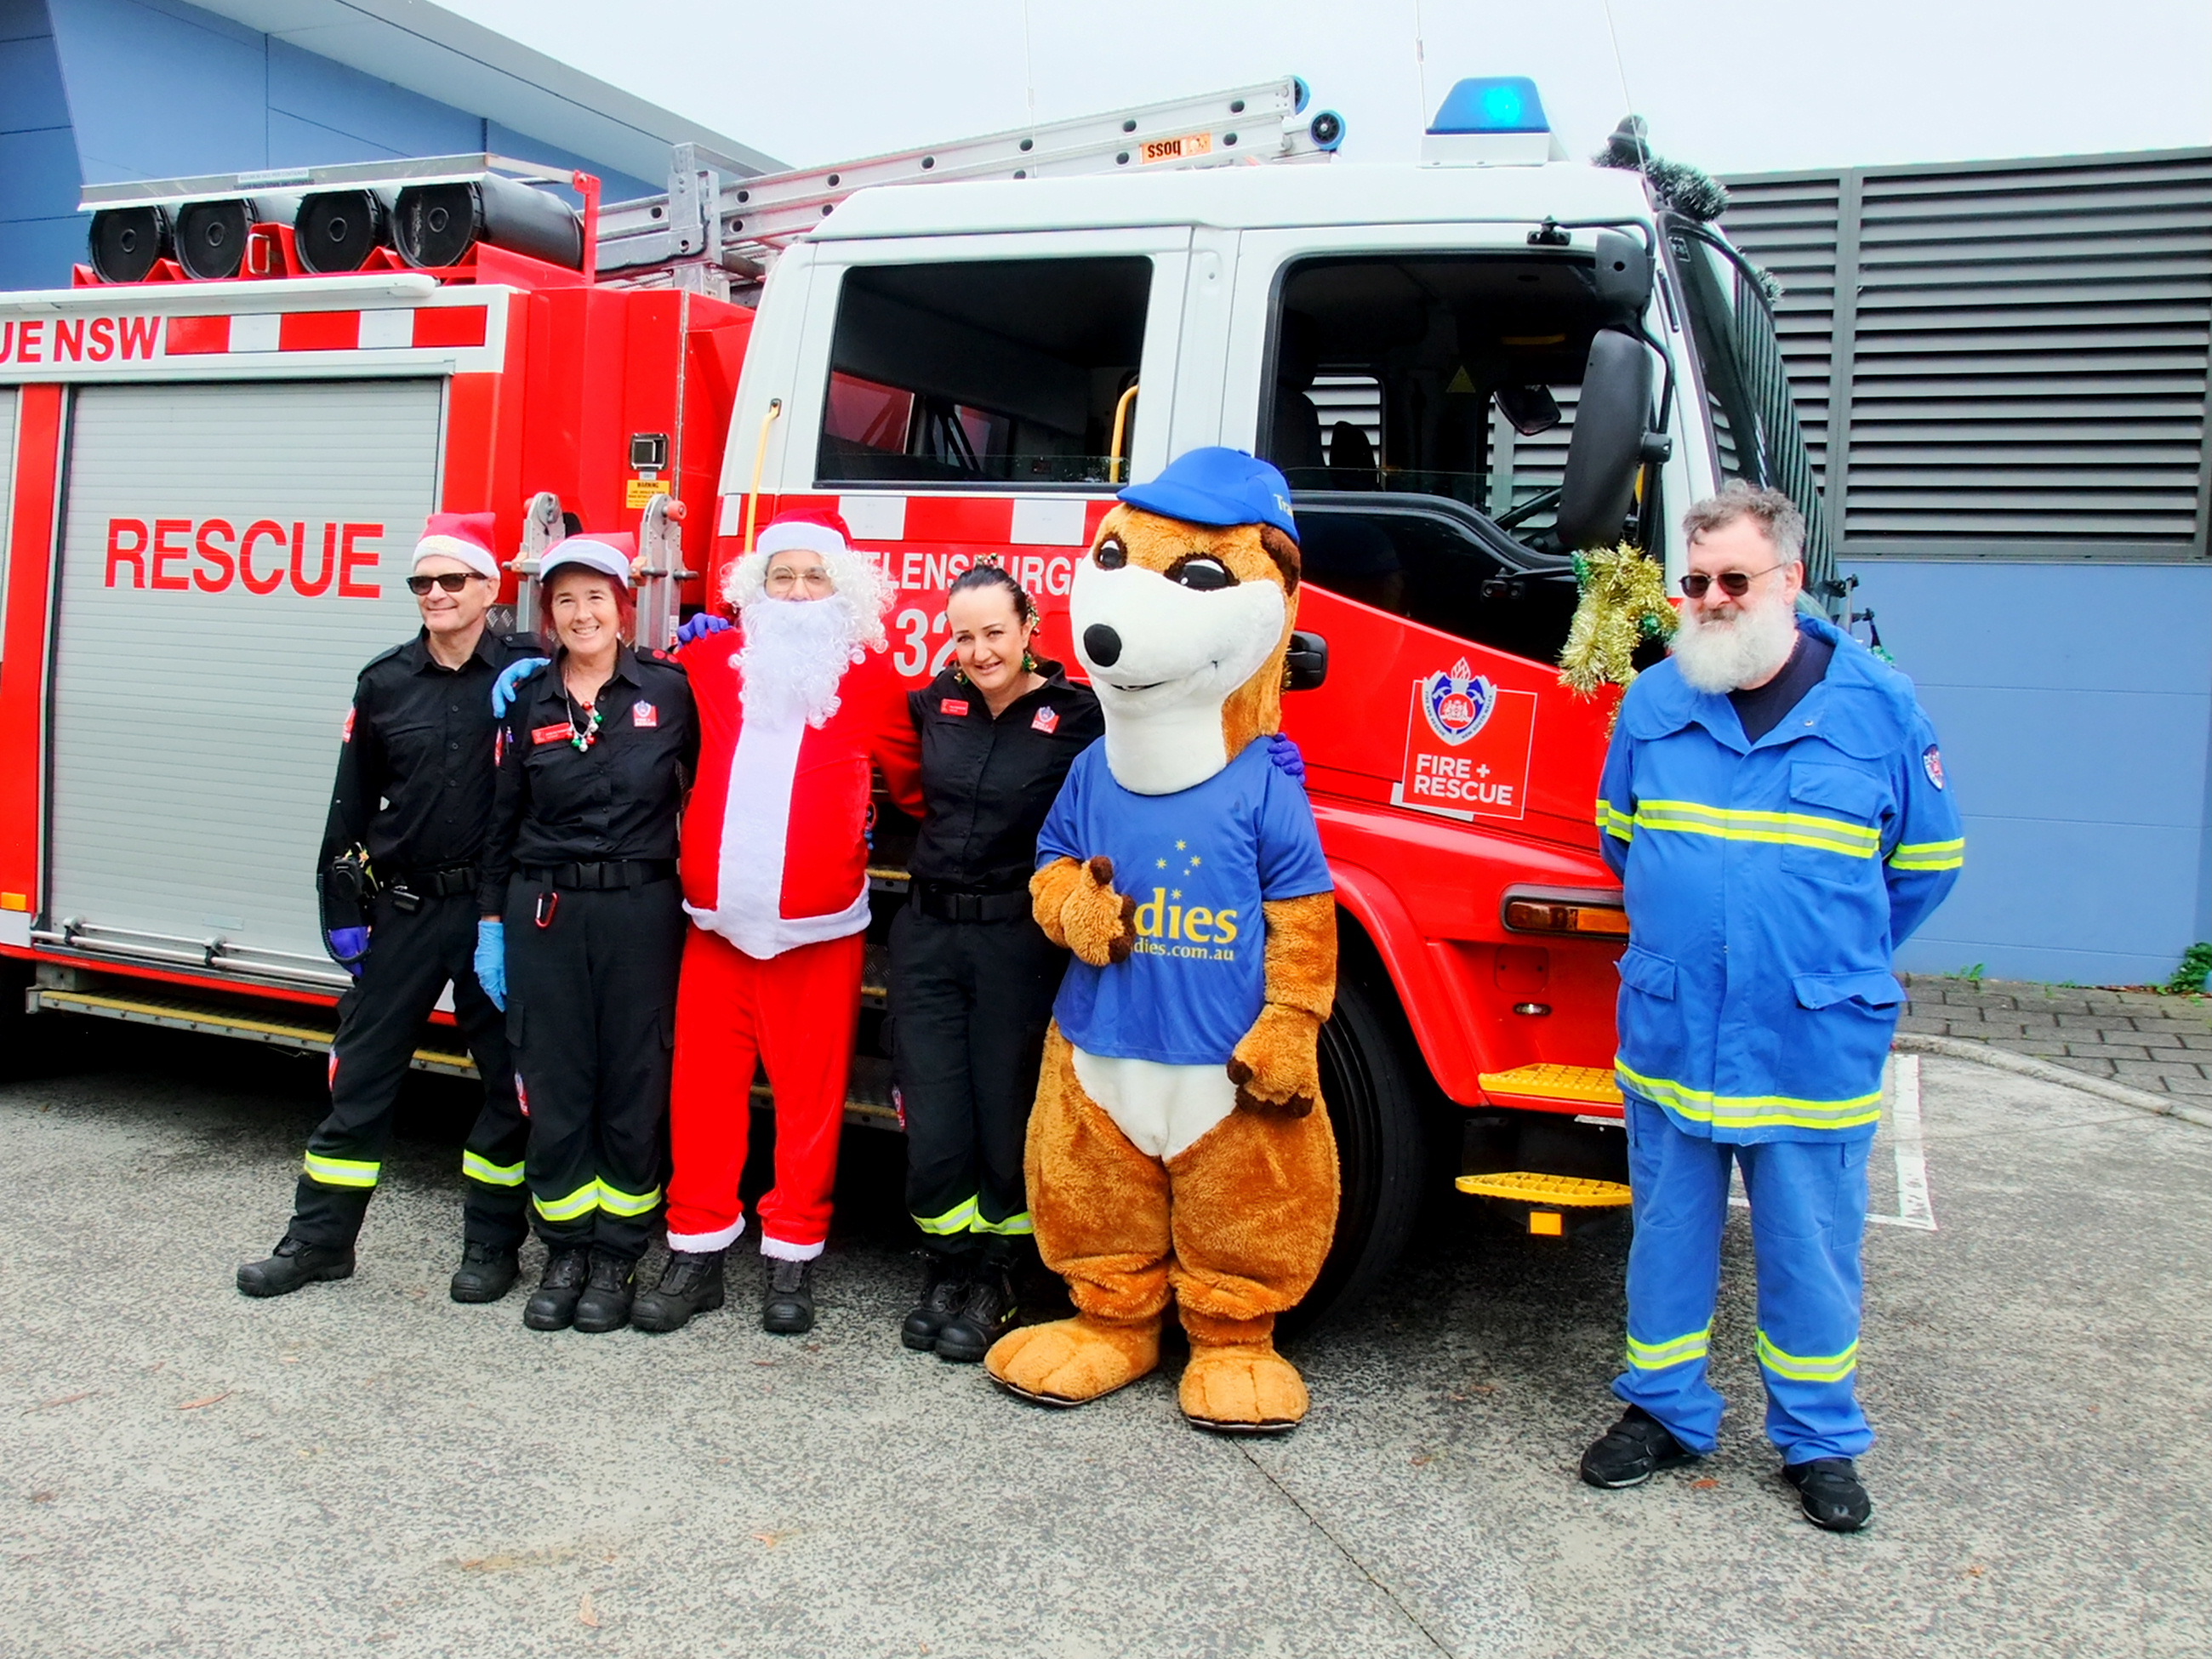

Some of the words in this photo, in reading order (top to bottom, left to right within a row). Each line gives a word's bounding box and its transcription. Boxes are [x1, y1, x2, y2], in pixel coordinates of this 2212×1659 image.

[1147, 140, 1181, 158] boss
[54, 316, 162, 362] NSW
[105, 518, 385, 598] RESCUE
[1416, 753, 1472, 779] FIRE
[1413, 774, 1514, 806] RESCUE
